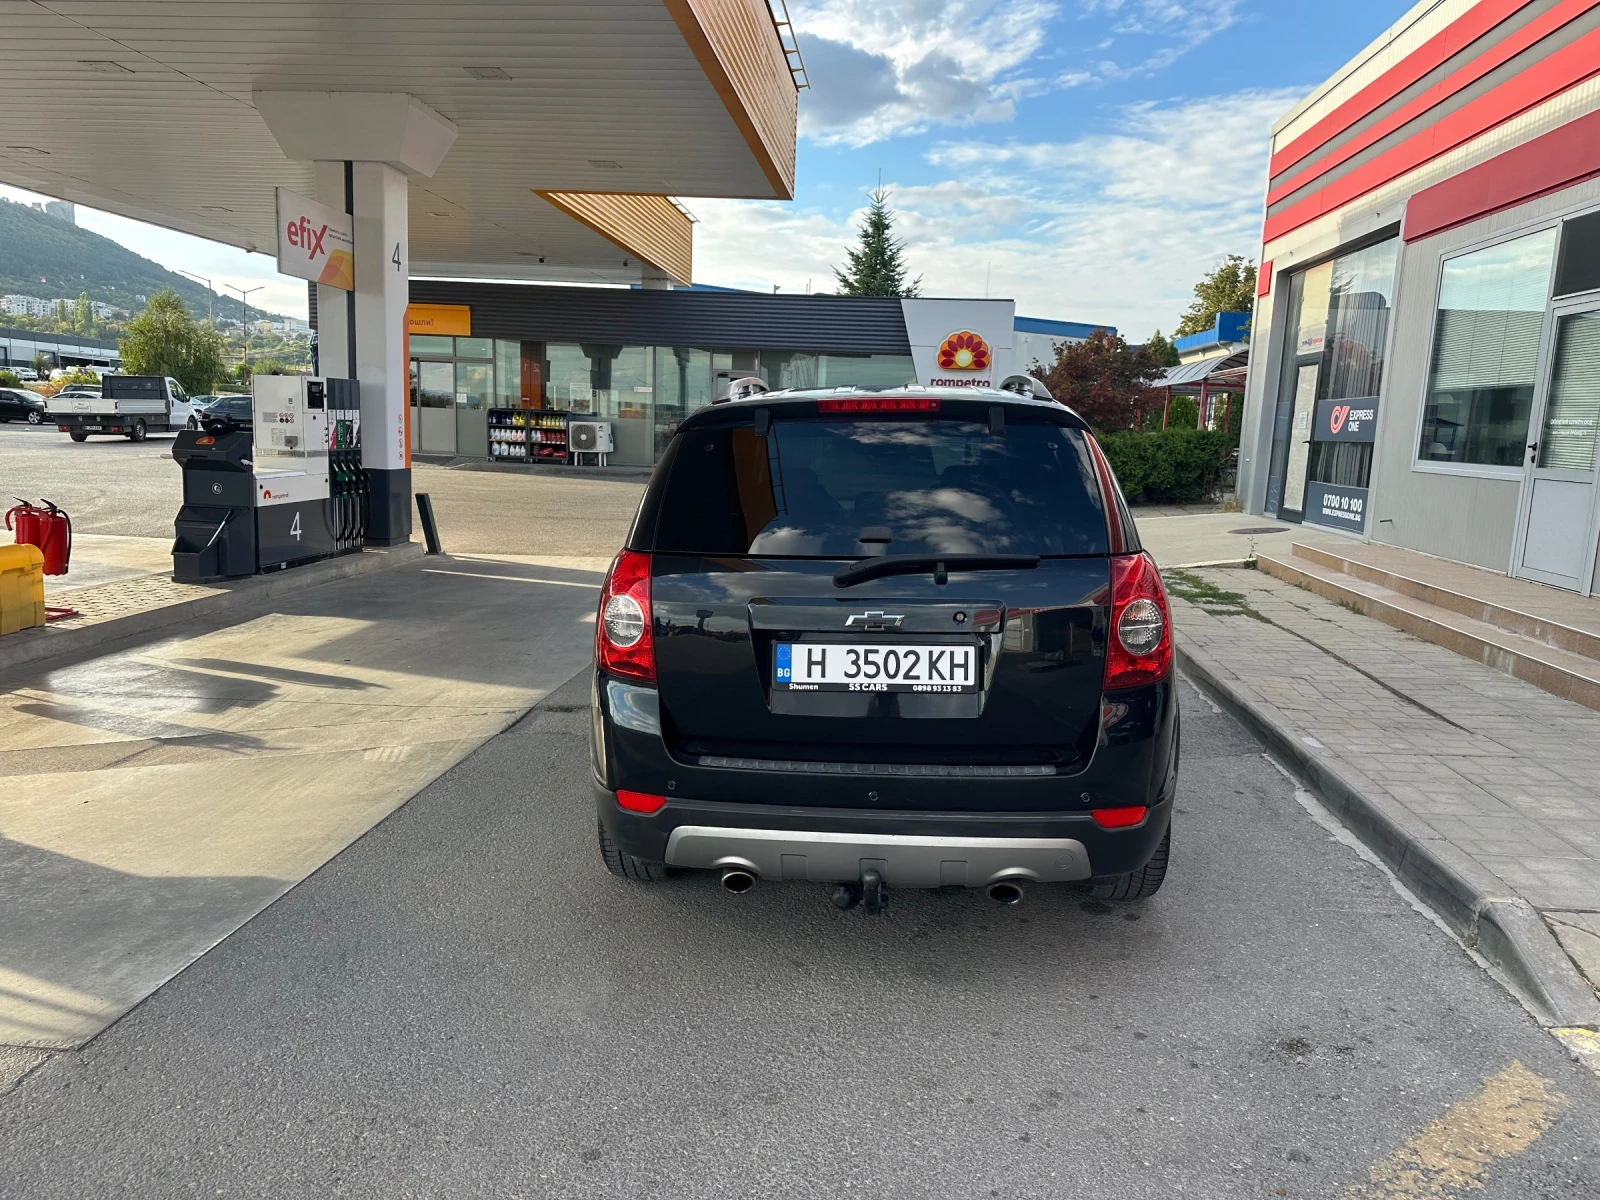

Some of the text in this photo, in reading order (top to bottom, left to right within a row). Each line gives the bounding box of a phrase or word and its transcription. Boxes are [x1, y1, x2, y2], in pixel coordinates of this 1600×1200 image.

[287, 216, 328, 260] efix
[391, 242, 402, 272] 4
[409, 318, 434, 326] ошли!
[1349, 408, 1374, 421] EXPRESS
[1347, 420, 1360, 432] ONE
[1323, 493, 1363, 513] 0700 10 100
[290, 511, 302, 541] 4
[806, 648, 827, 679] H
[777, 668, 790, 677] BG
[788, 682, 819, 691] Shumen
[862, 683, 888, 692] CARS
